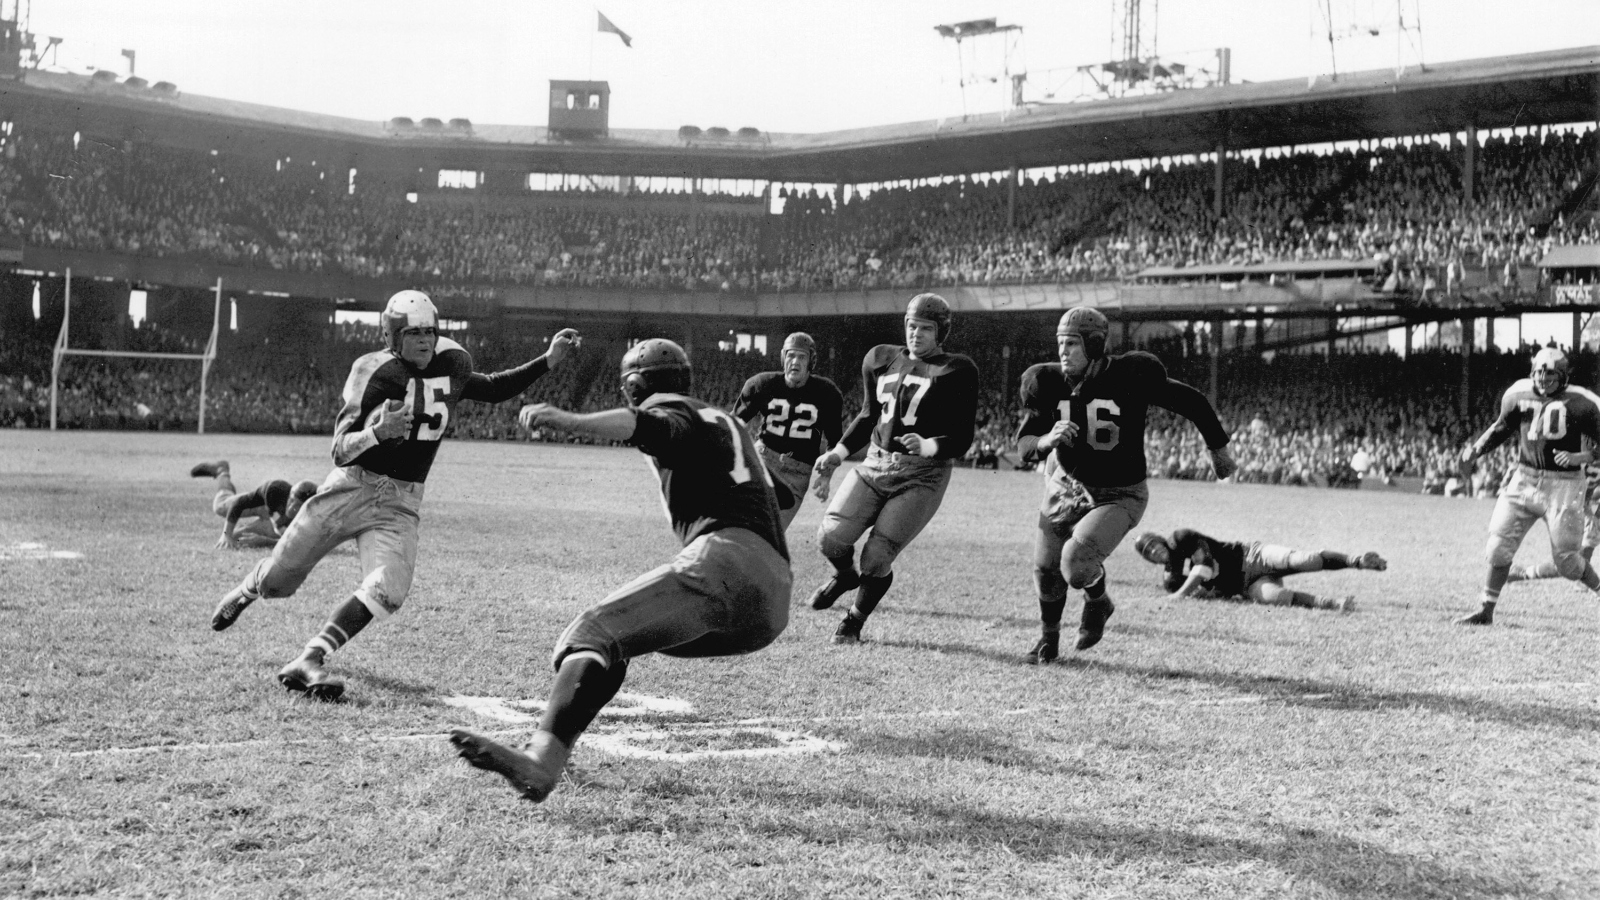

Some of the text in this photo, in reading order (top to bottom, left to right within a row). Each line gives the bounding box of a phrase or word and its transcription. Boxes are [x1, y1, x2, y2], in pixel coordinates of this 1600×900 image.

[404, 375, 451, 441] 15
[766, 398, 818, 439] 22
[876, 372, 931, 426] 57
[1517, 399, 1567, 440] 70
[697, 407, 775, 487] 7
